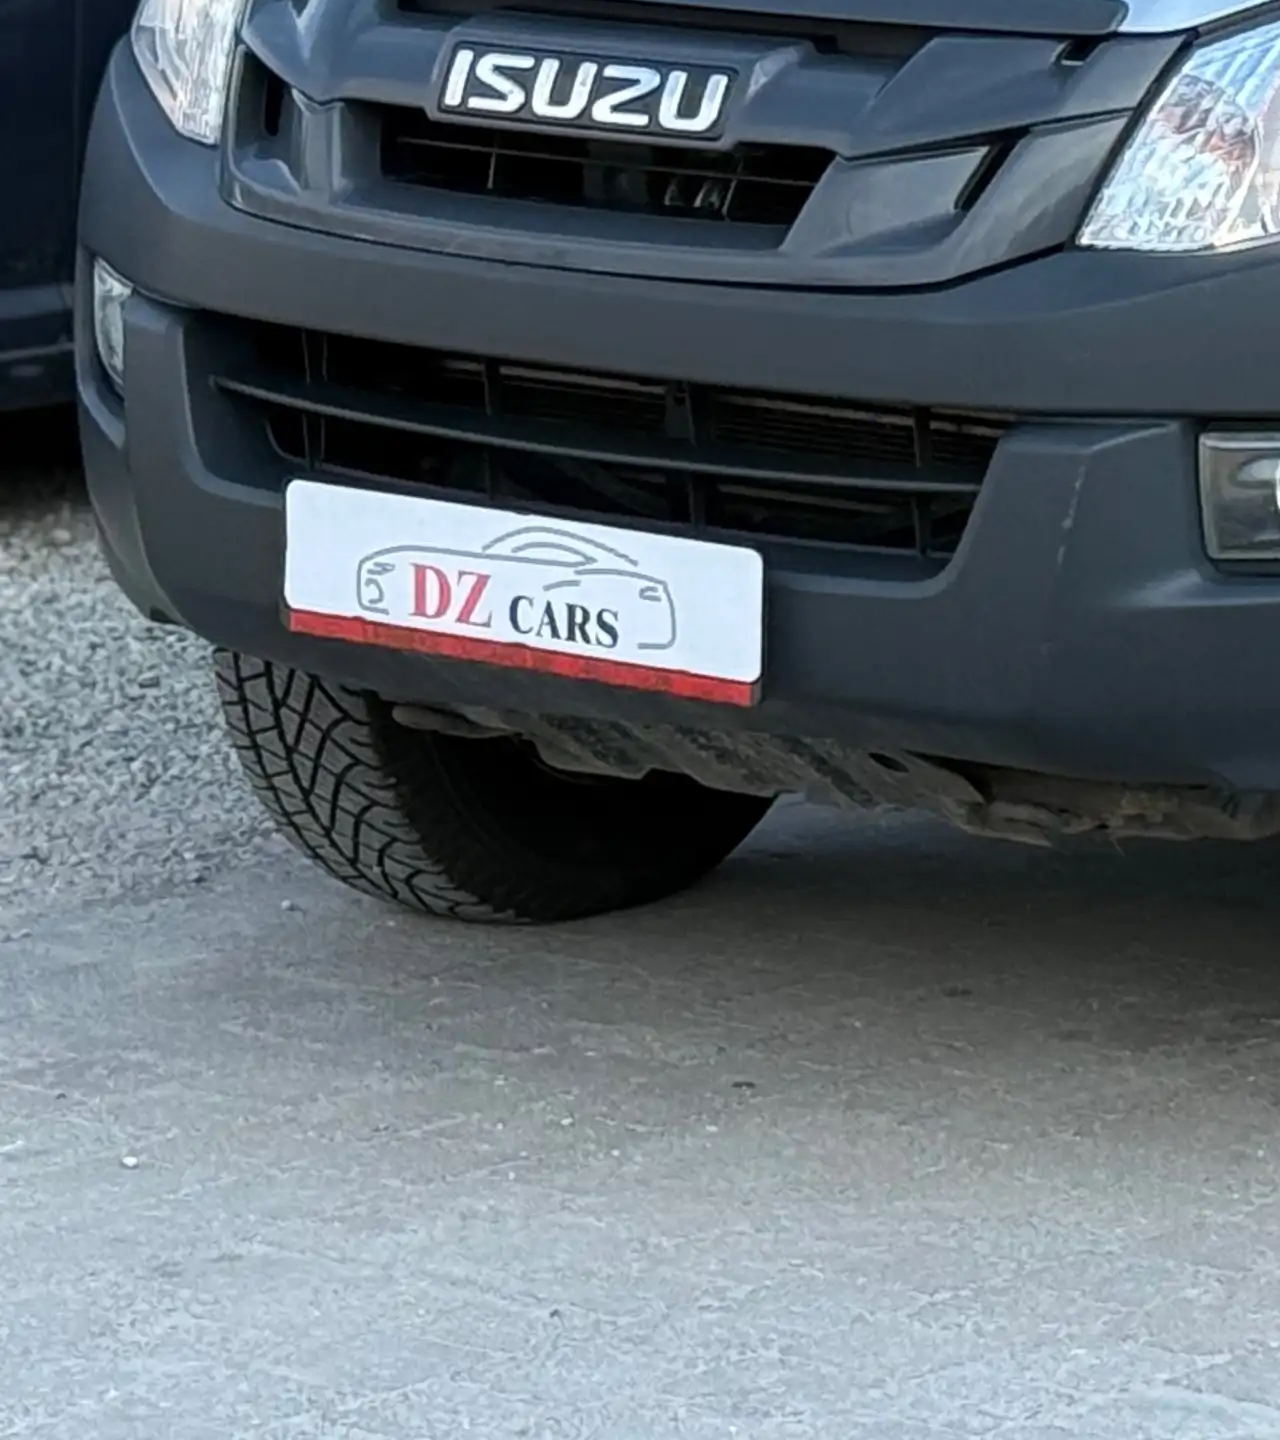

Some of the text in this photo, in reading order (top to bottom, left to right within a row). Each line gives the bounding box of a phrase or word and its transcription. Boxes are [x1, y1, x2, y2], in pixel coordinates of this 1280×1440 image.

[444, 49, 729, 132] ISUZU
[409, 562, 619, 649] DZ CARS
